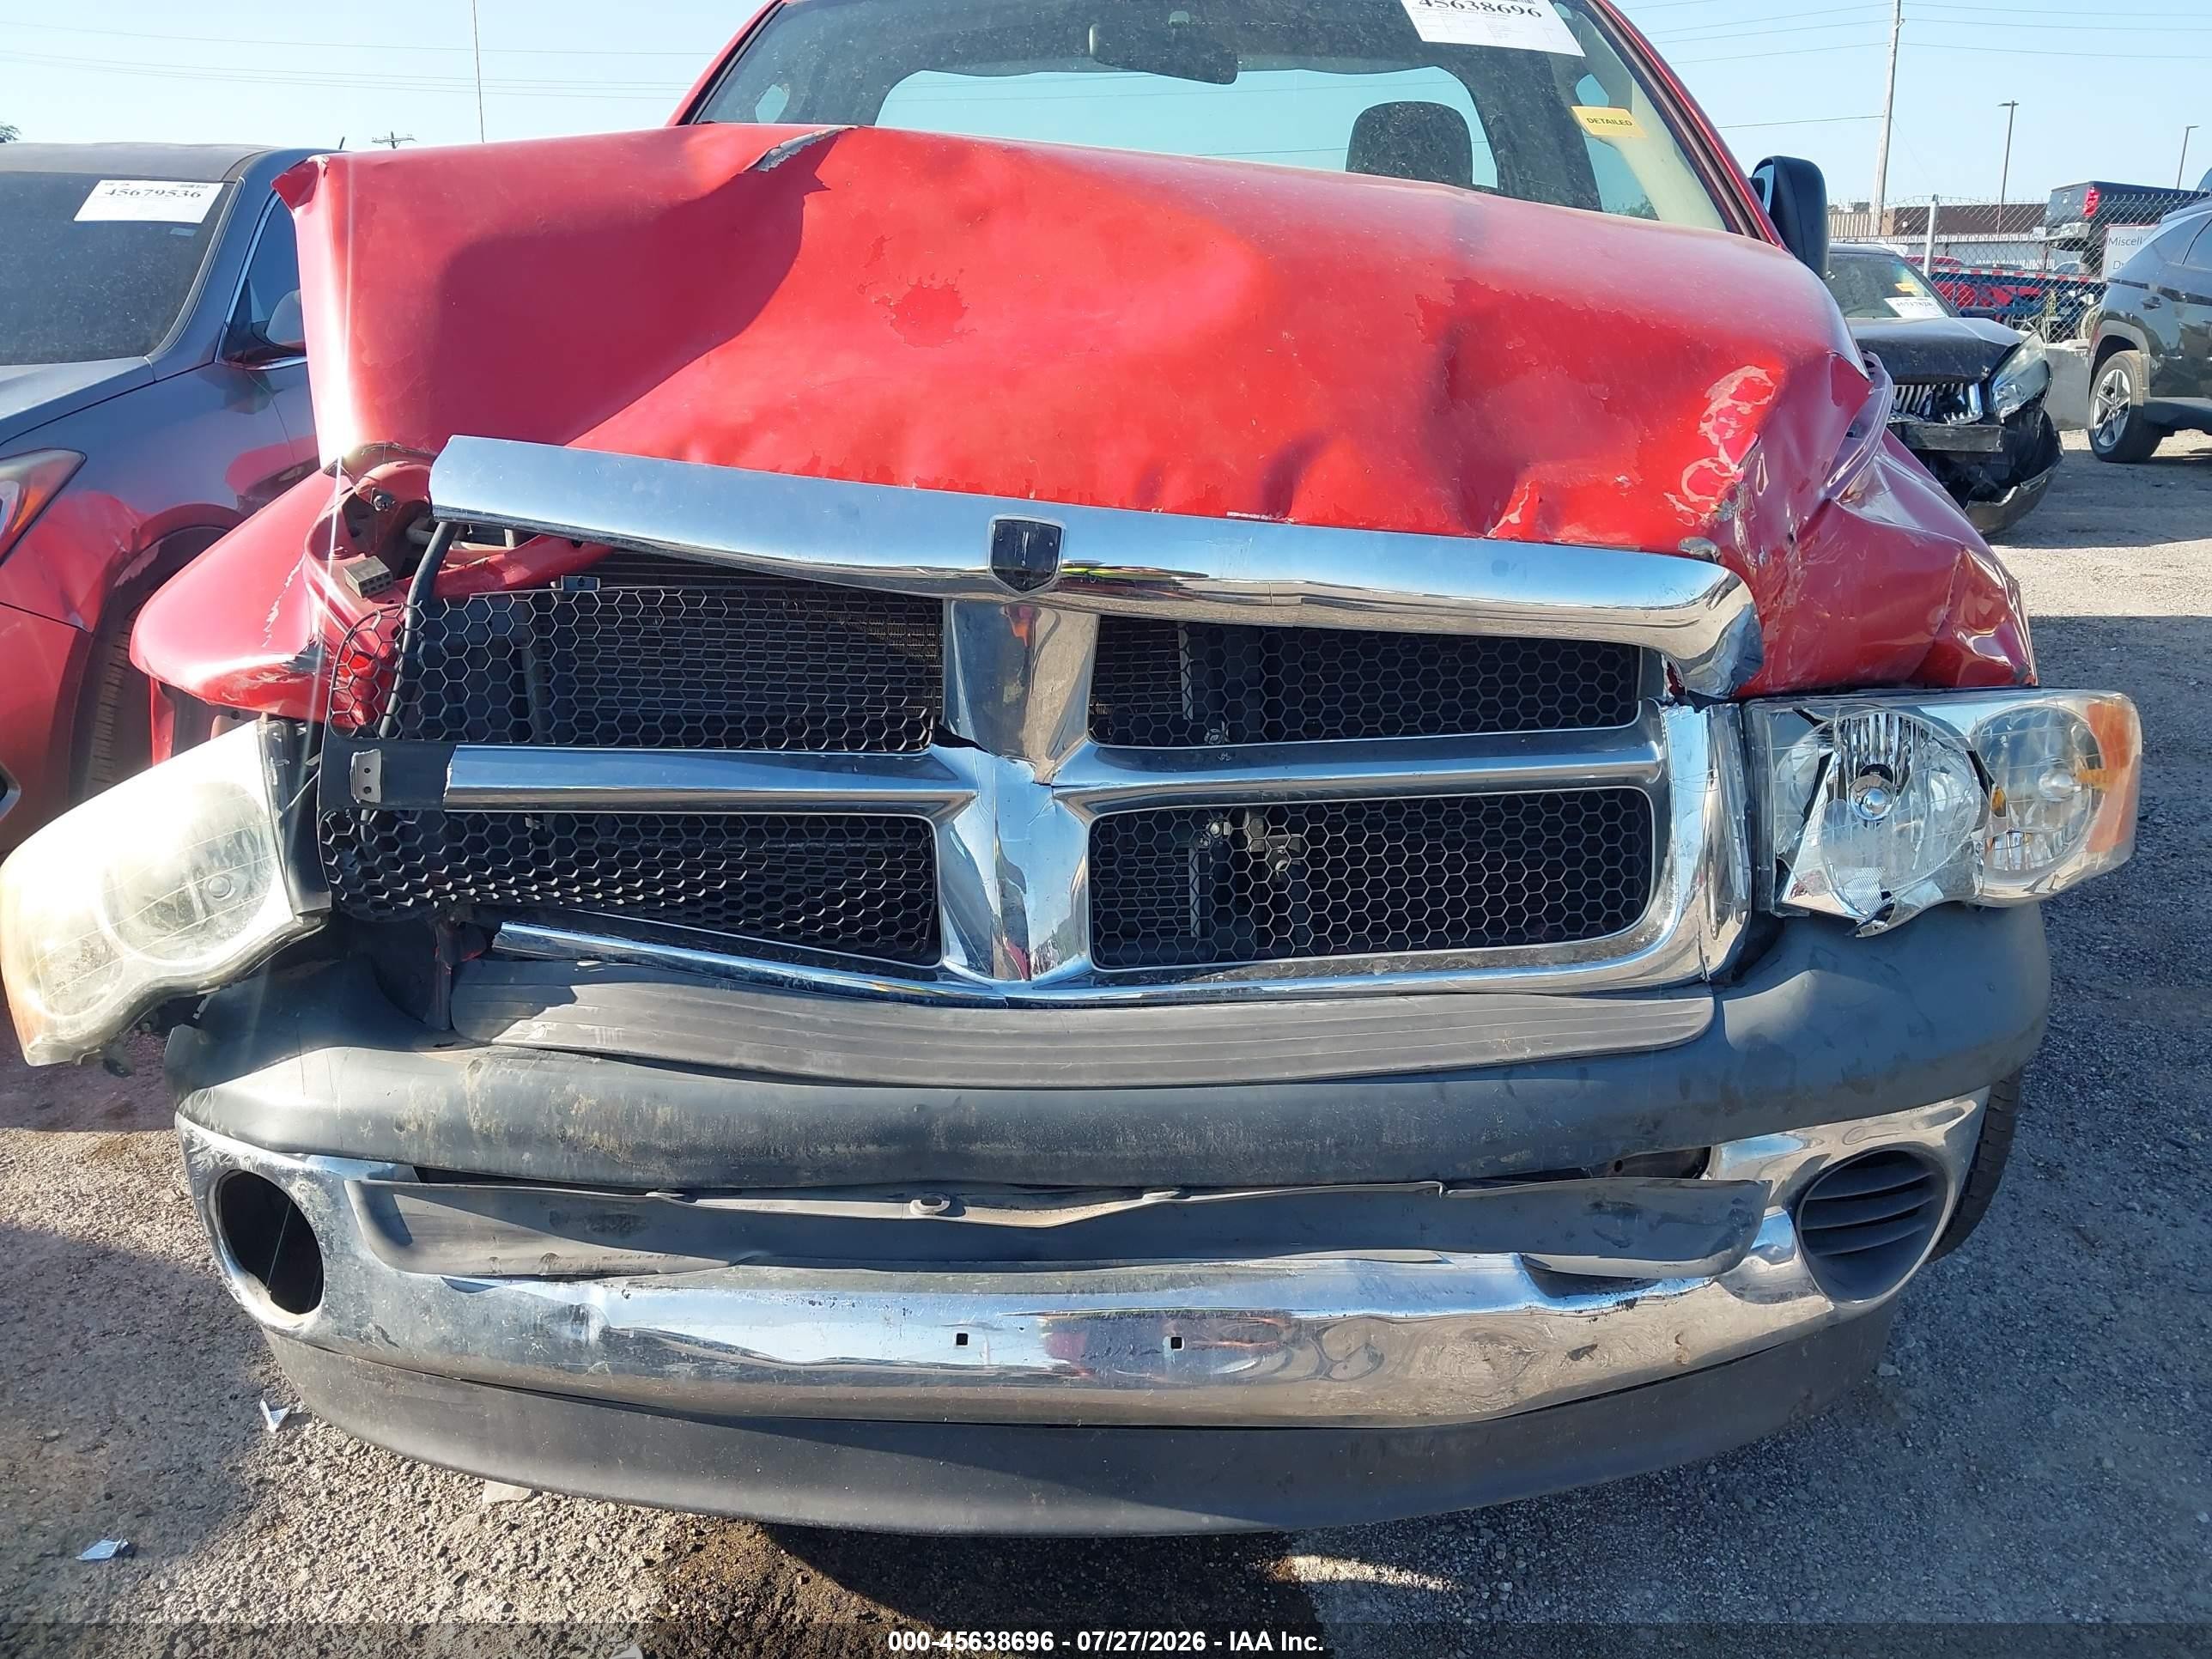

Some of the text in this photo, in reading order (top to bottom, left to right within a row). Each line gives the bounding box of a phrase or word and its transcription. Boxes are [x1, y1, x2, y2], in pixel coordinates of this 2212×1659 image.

[1419, 0, 1543, 18] 45638696
[1586, 118, 1633, 126] DETAILED
[105, 189, 202, 198] 45679536
